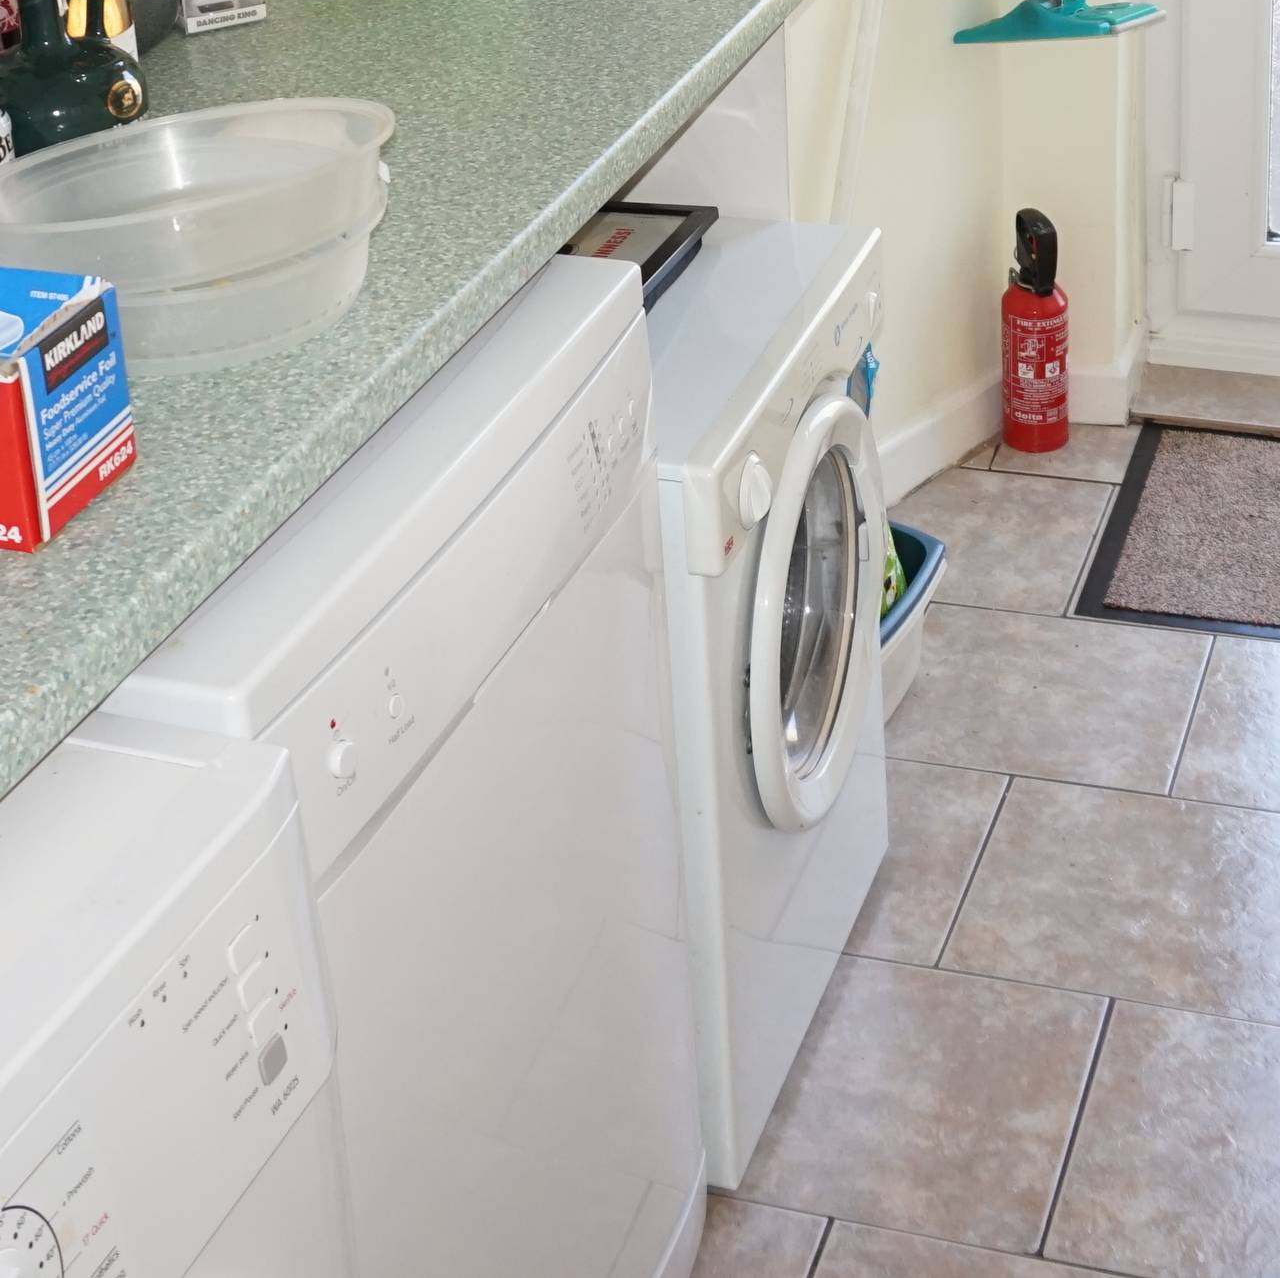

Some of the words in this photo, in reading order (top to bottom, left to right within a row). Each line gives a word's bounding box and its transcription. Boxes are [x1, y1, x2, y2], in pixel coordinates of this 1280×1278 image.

[196, 13, 236, 28] DANCING
[237, 9, 258, 20] KING
[43, 311, 106, 372] KIRKLAND
[40, 370, 98, 425] Foodservice
[98, 351, 117, 377] Foil
[43, 417, 64, 441] Super
[63, 392, 94, 425] Premium
[93, 373, 116, 399] Quality
[98, 440, 134, 482] RK624
